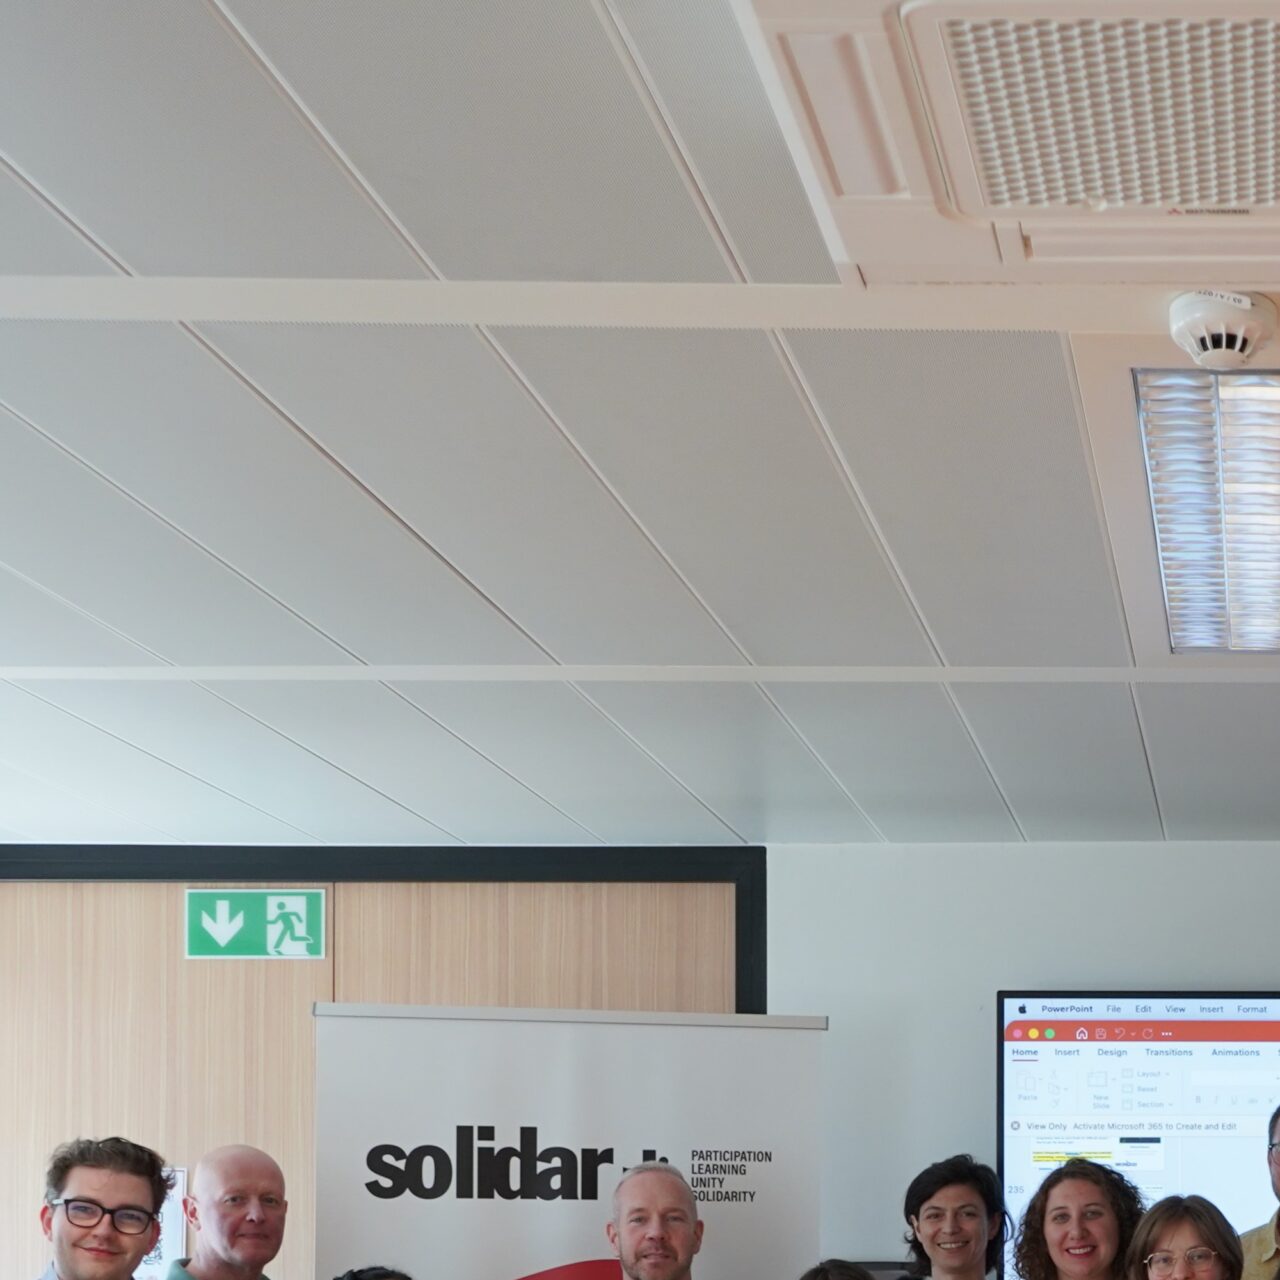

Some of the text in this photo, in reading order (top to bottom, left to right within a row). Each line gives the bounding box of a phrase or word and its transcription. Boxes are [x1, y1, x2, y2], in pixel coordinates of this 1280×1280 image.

[1042, 1005, 1093, 1014] PowerPoint
[1106, 1005, 1122, 1014] File
[1135, 1005, 1152, 1014] Edit
[1165, 1005, 1186, 1014] View
[1200, 1005, 1224, 1014] Insert
[1237, 1005, 1267, 1014] Format
[1012, 1048, 1038, 1056] Home
[1055, 1048, 1080, 1056] Insert
[1097, 1048, 1127, 1058] Design
[1145, 1048, 1193, 1056] Transitions
[1212, 1048, 1260, 1056] Animations
[1027, 1122, 1068, 1131] View Only
[1073, 1122, 1237, 1130] Activate Microsoft 365 to Create and Edit
[691, 1150, 772, 1162] PARTICIPATION
[364, 1125, 614, 1200] solidar
[691, 1163, 747, 1175] LEARNING
[691, 1177, 725, 1188] UNITY
[1008, 1186, 1025, 1194] 235
[692, 1190, 756, 1202] SOLIDARITY
